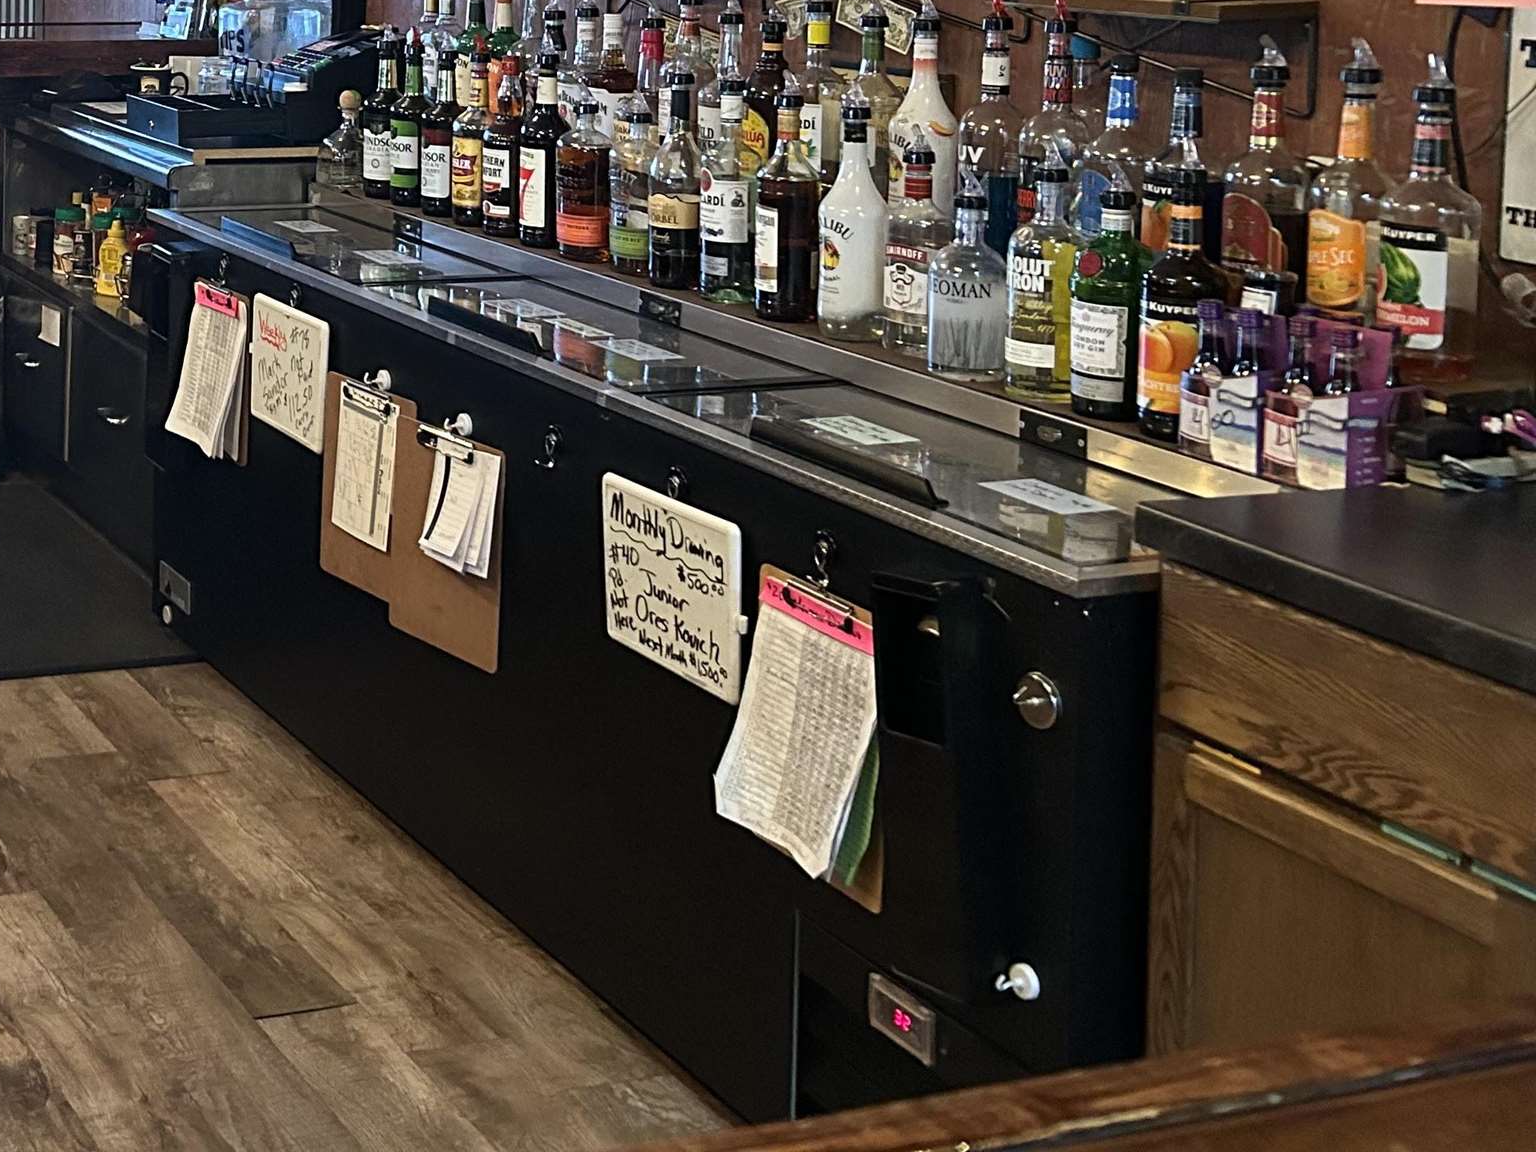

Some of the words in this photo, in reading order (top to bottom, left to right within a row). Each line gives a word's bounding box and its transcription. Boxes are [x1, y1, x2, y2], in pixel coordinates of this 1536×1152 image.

[958, 145, 986, 163] UV
[610, 491, 667, 557] Monthly
[667, 516, 725, 583] Drawing
[609, 543, 640, 566] #40
[610, 589, 630, 610] Not
[639, 567, 690, 612] Junior
[613, 612, 637, 632] Here
[639, 630, 664, 657] Next
[664, 643, 687, 668] Month
